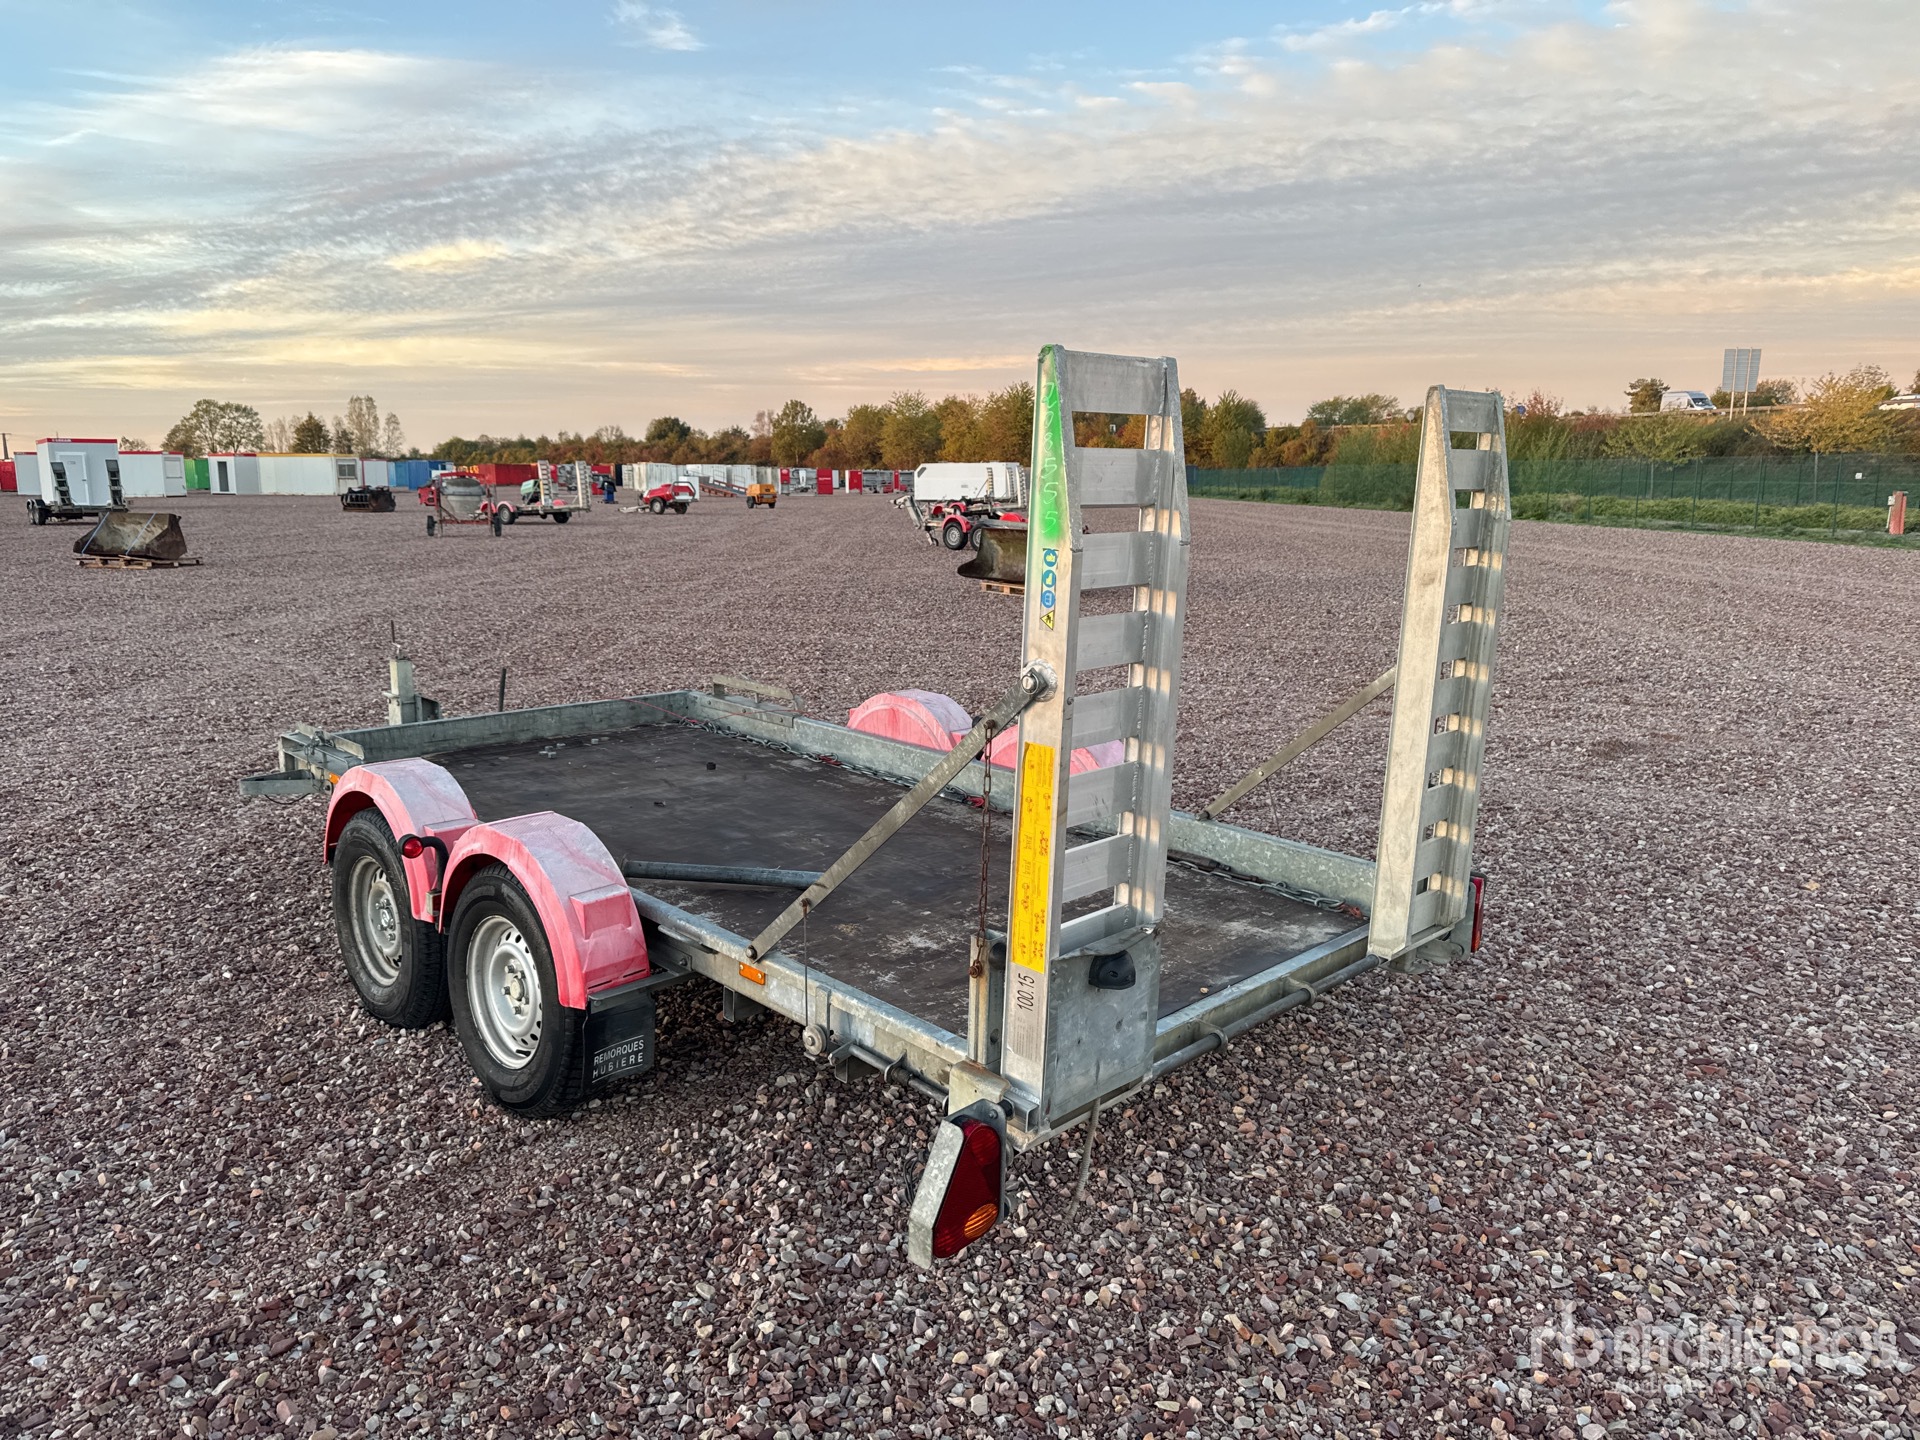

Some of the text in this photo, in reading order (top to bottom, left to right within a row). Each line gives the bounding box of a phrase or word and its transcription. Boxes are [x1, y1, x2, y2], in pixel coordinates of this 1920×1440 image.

[1017, 973, 1035, 1012] 100.15
[592, 1052, 644, 1079] HUBIERE
[594, 1040, 644, 1066] REMORQUES
